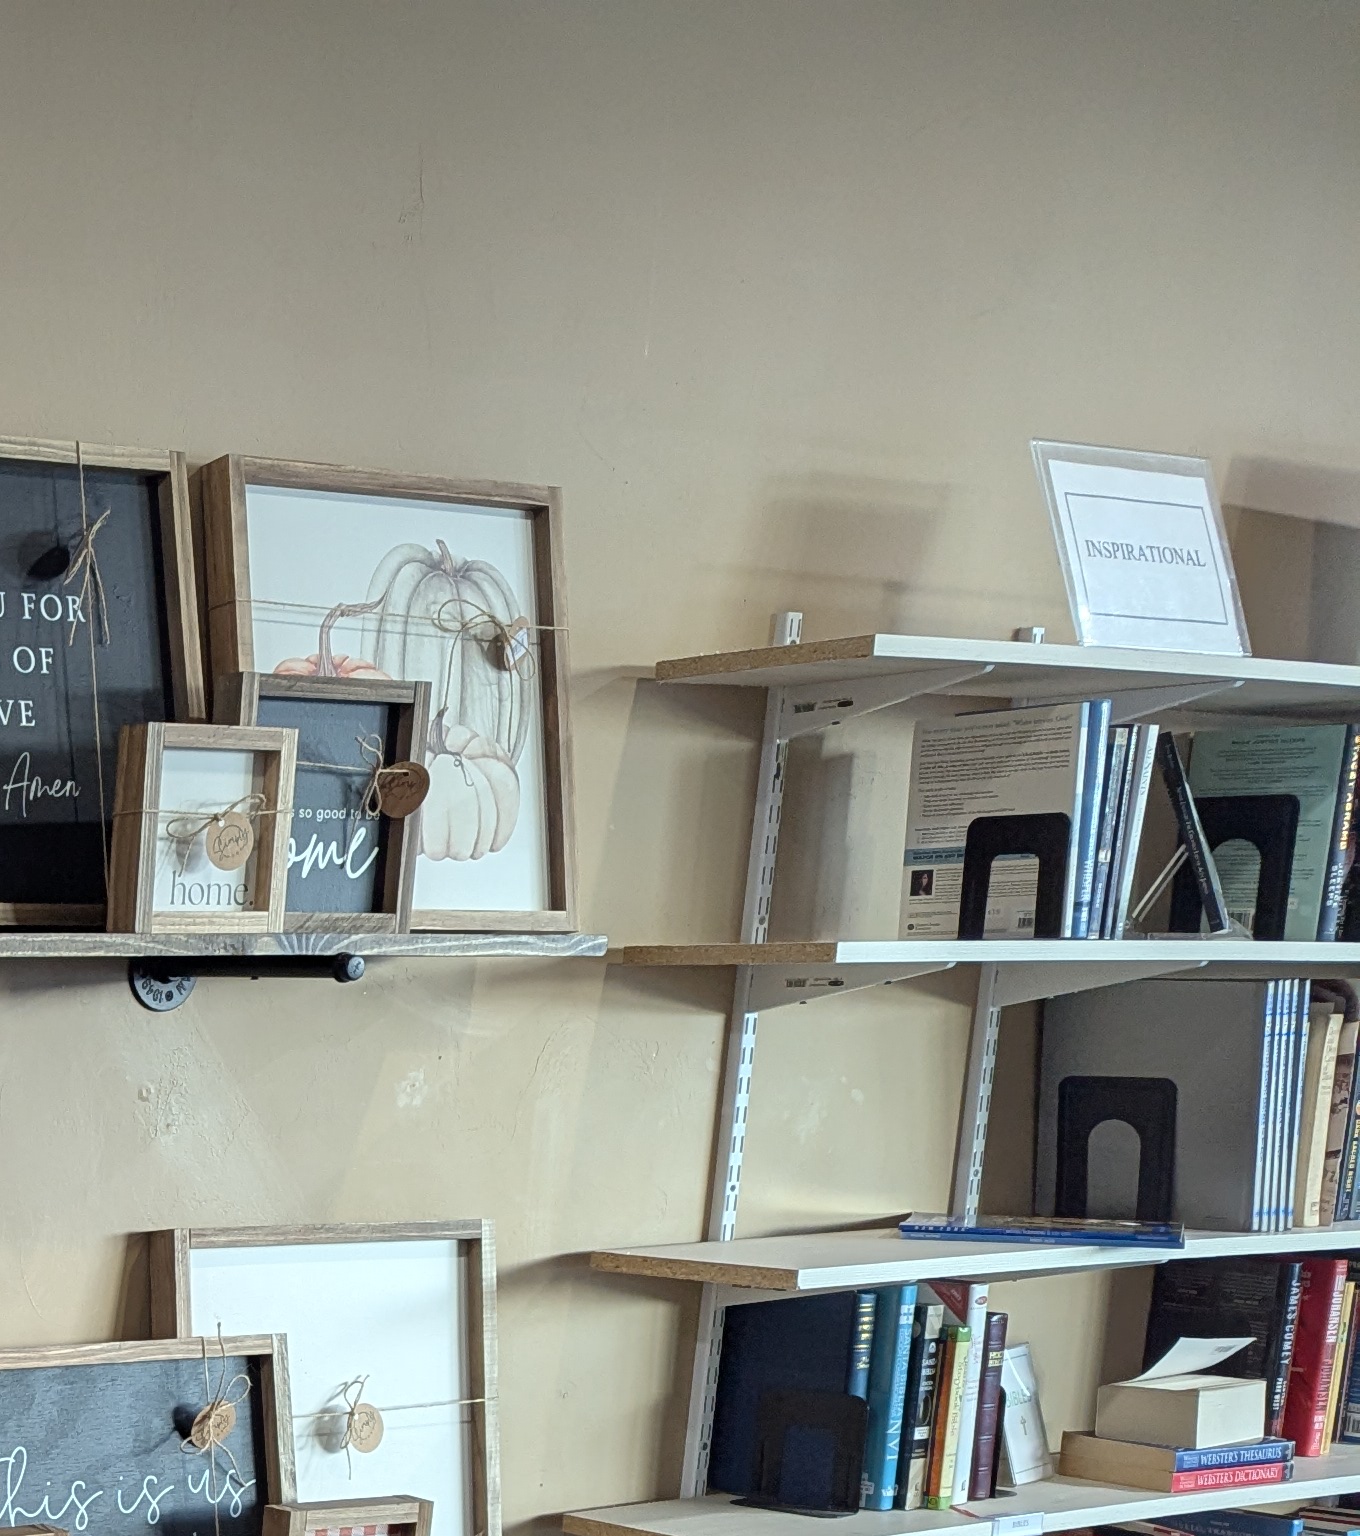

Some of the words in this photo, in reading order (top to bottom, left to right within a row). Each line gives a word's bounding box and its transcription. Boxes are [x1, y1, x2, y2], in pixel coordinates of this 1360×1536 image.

[1085, 540, 1206, 567] INSPIRATIONAL
[23, 593, 85, 623] FOR
[3, 752, 79, 817] Amen
[299, 809, 312, 818] so
[317, 809, 346, 822] good
[287, 825, 379, 879] ome
[170, 871, 254, 906] home.
[1286, 1280, 1301, 1320] JAMES
[1280, 1324, 1295, 1364] COMEY
[1200, 1452, 1238, 1465] WEBSTER'S
[1239, 1447, 1281, 1462] THESAURUS
[1197, 1473, 1233, 1486] WEBSTER'S
[1234, 1468, 1279, 1482] DICTIONARY
[118, 1475, 174, 1524] is
[188, 1467, 256, 1518] us
